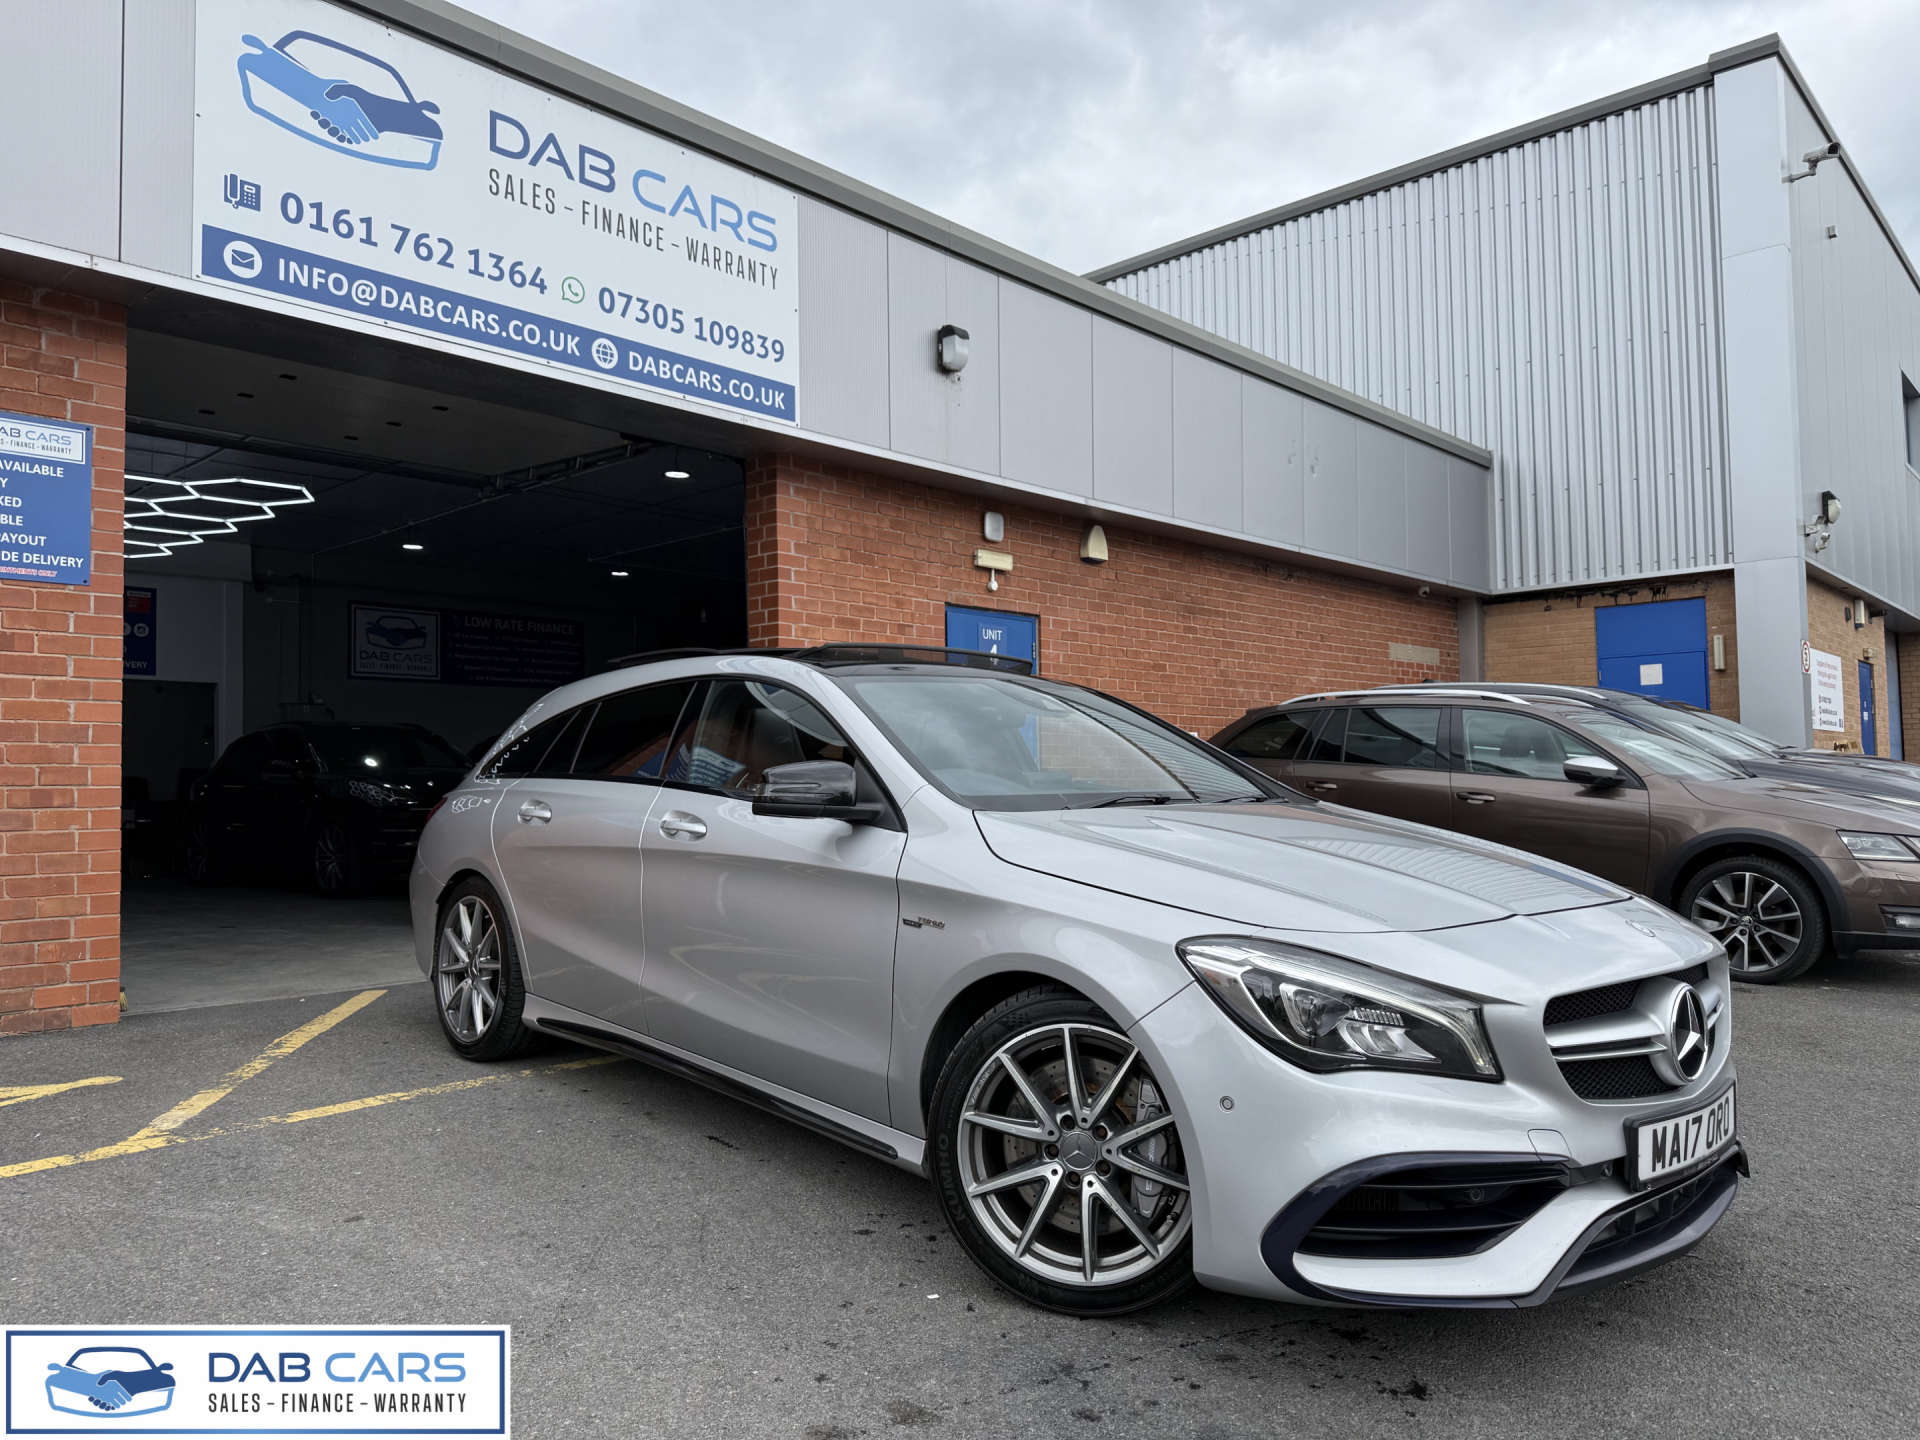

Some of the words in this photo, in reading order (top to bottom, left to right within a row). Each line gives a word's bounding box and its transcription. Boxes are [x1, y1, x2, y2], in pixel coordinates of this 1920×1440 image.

[489, 110, 616, 193] DAB
[632, 168, 778, 252] CARS
[280, 192, 378, 248] 0161
[390, 224, 454, 268] 762
[468, 248, 548, 294] 1364
[488, 168, 556, 214] SALES
[582, 201, 664, 252] FINANCE
[686, 240, 778, 290] WARRANTY
[278, 258, 580, 356] INFO@DABCARS.CO.UK
[599, 286, 685, 334] 07305
[694, 316, 785, 364] 109839
[629, 351, 786, 410] DABCARS.CO.UK
[25, 430, 72, 446] CARS
[0, 532, 47, 547] AYOUT
[22, 552, 84, 568] DELIVERY
[983, 628, 1002, 641] UNIT
[1652, 1114, 1703, 1173] MA17
[1705, 1096, 1730, 1149] ORO
